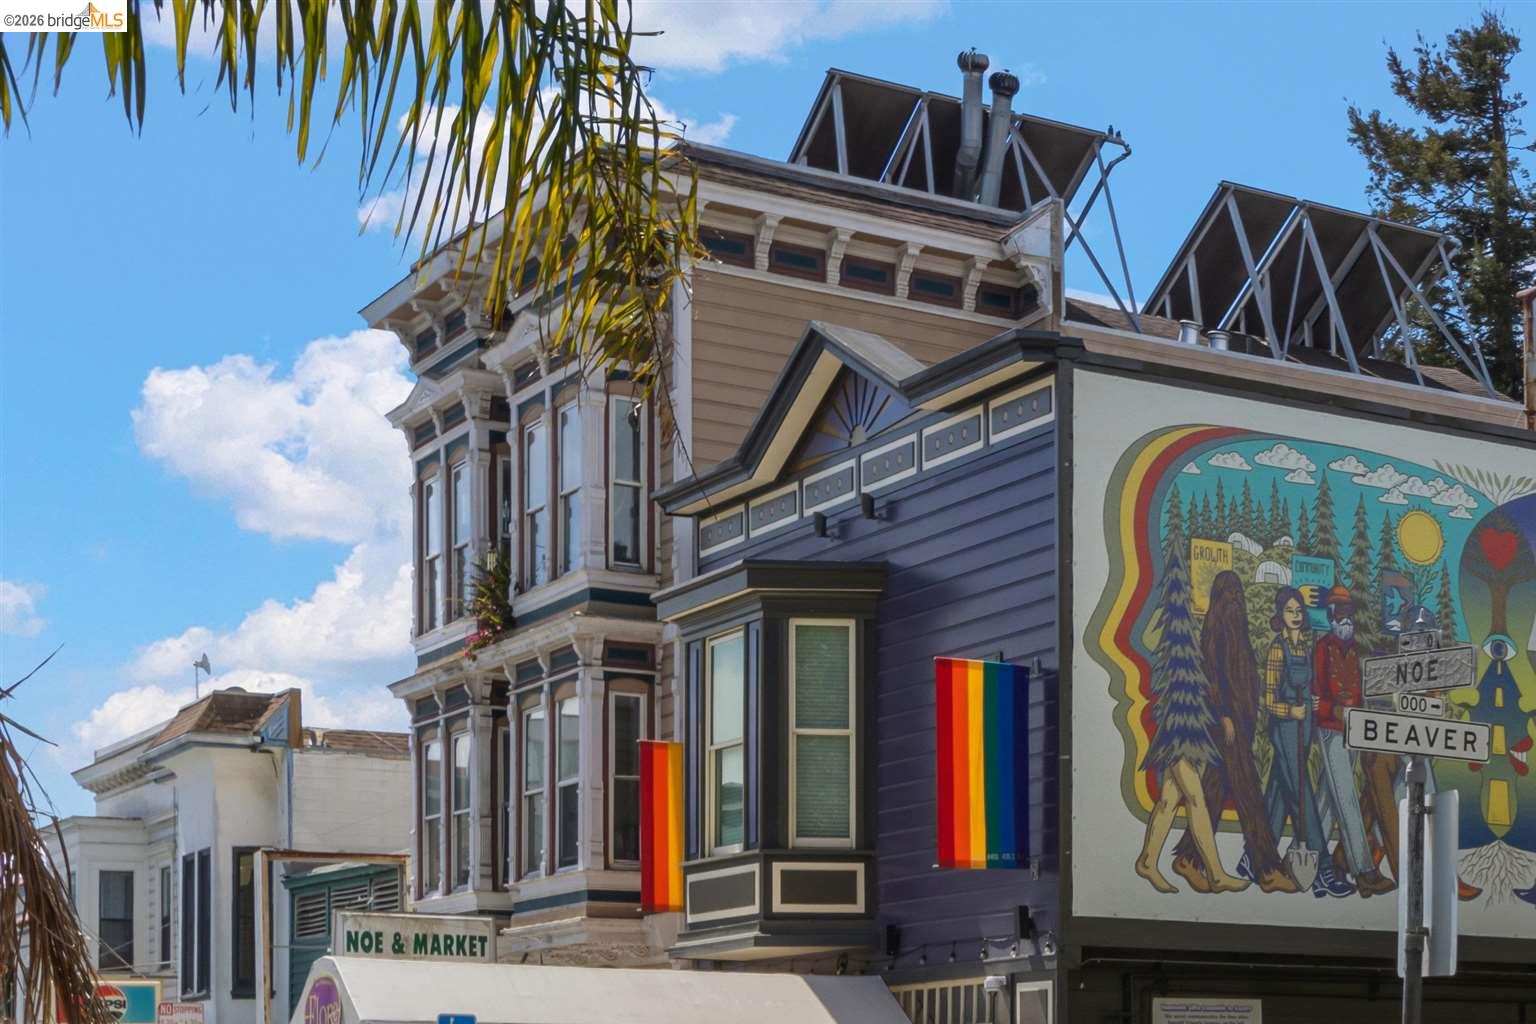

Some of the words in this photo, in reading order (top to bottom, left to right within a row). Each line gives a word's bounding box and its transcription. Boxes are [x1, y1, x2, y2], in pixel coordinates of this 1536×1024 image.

[1396, 659, 1438, 685] NOE
[1401, 695, 1427, 712] 000
[1364, 719, 1477, 752] BEAVER
[346, 930, 384, 953] NOE
[391, 932, 405, 955] &
[413, 933, 488, 957] MARKET
[160, 1003, 172, 1014] NO
